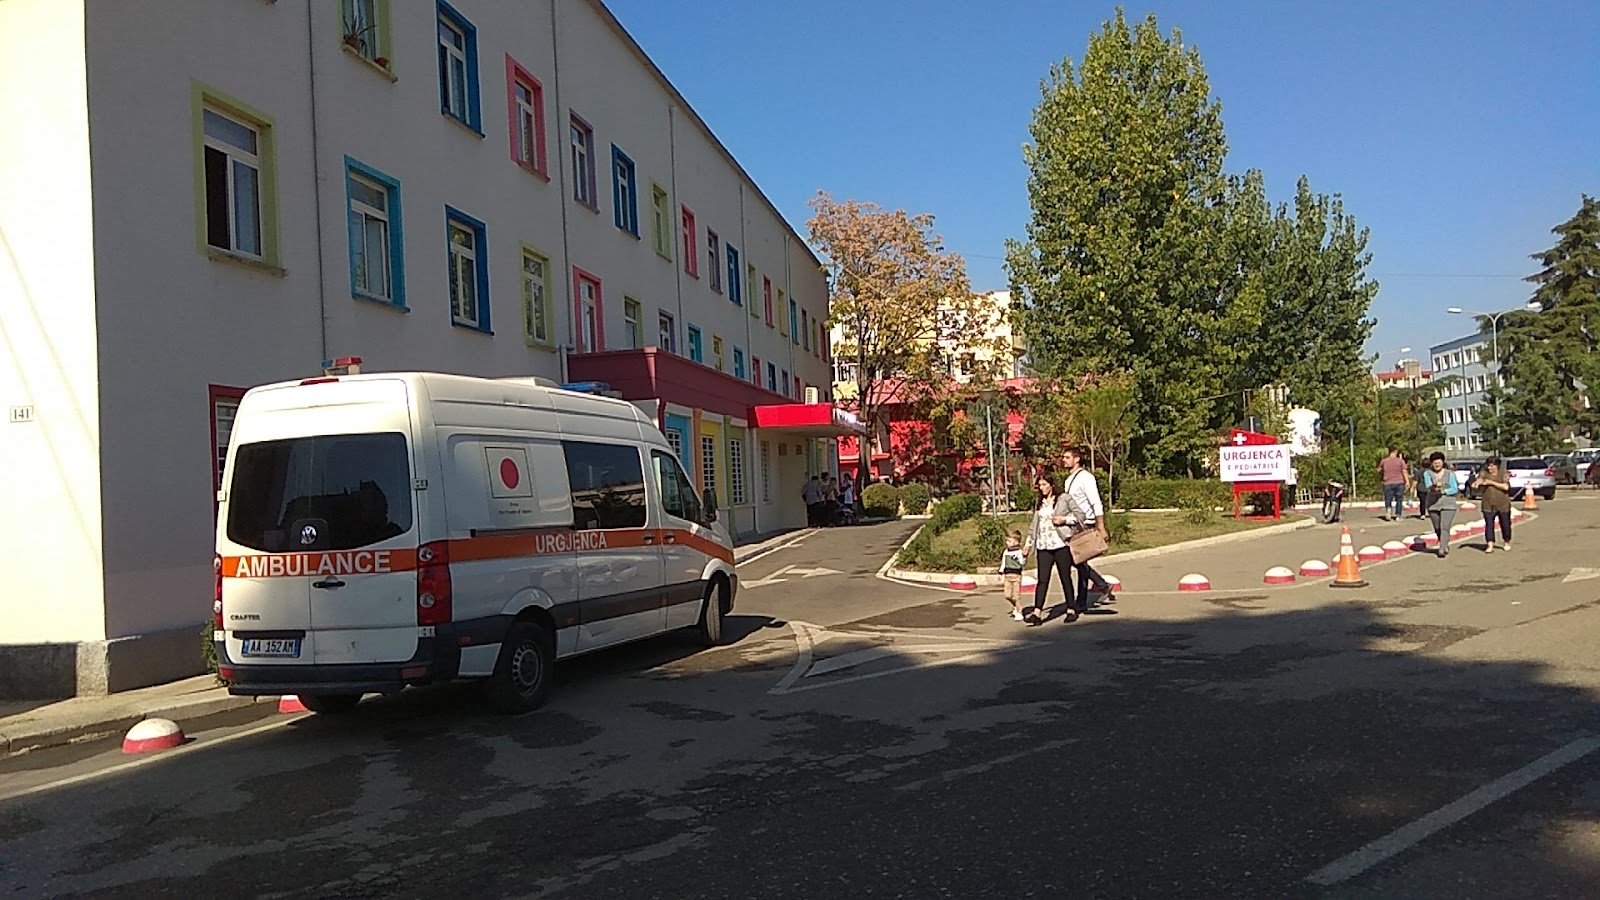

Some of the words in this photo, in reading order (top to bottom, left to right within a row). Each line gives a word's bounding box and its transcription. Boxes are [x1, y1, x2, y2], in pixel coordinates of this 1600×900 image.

[14, 408, 30, 420] 141
[1223, 450, 1283, 461] URGJENCA
[535, 532, 608, 553] URGJENCA
[236, 551, 391, 578] AMBULANCE
[251, 641, 261, 653] AA
[265, 641, 282, 653] 152
[282, 641, 294, 653] AM
